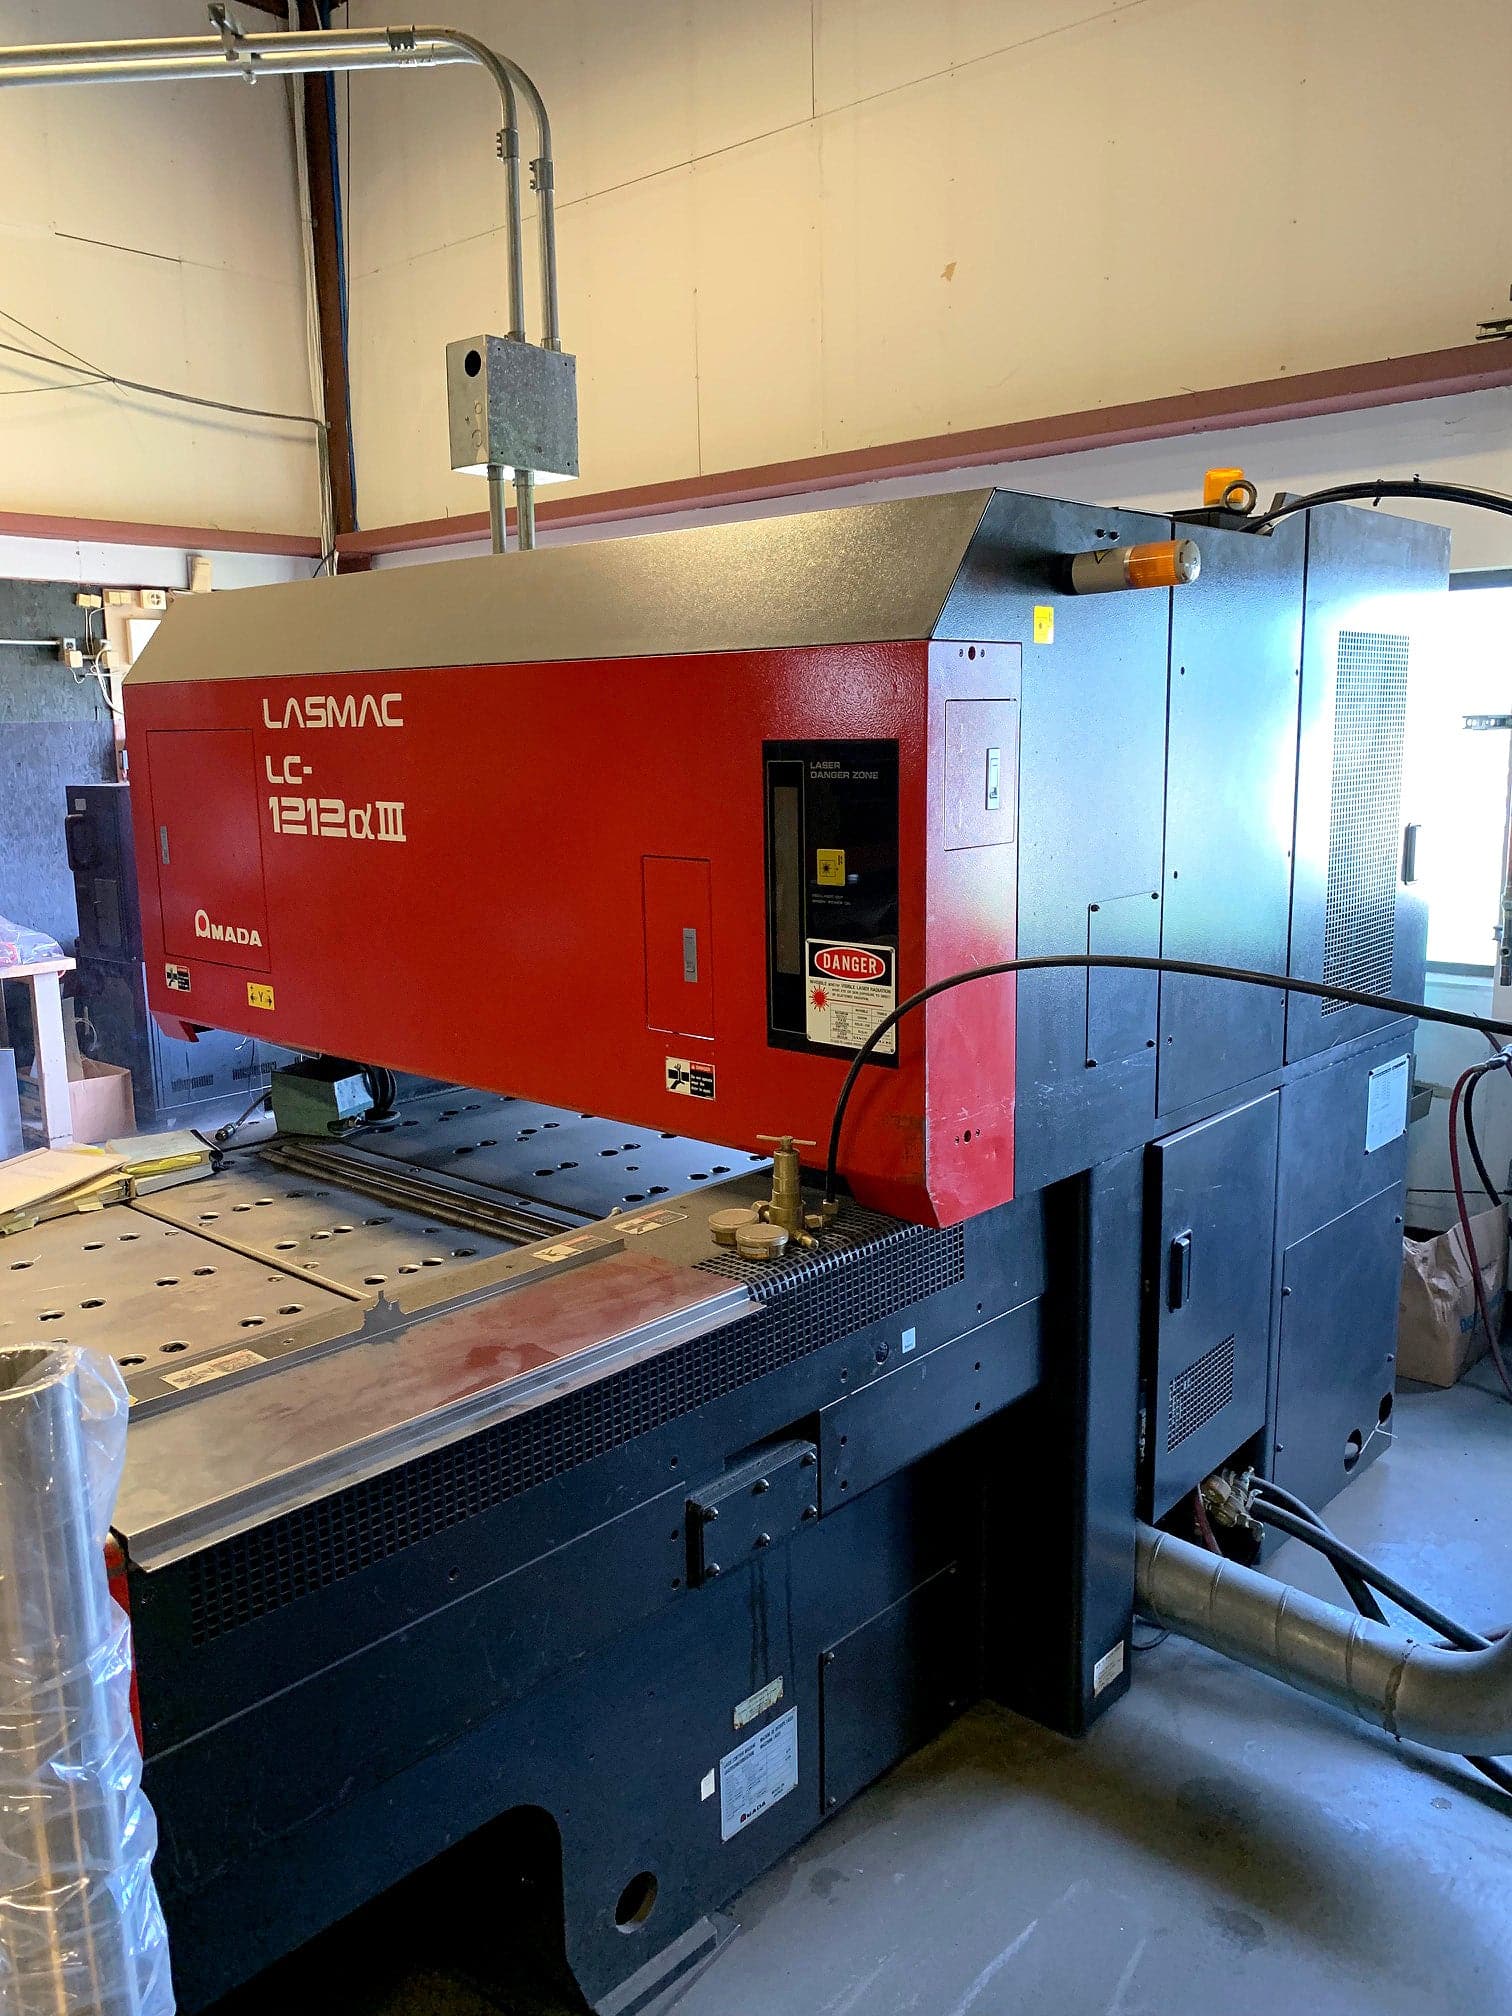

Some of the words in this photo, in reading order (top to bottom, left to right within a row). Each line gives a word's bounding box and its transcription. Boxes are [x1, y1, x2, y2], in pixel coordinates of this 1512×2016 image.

[262, 693, 404, 729] LASMAC
[265, 755, 313, 784] LC-
[810, 761, 841, 769] LASER
[810, 771, 850, 779] DANGER
[852, 771, 879, 779] ZONE
[194, 909, 263, 948] AMADA
[823, 953, 877, 974] DANGER
